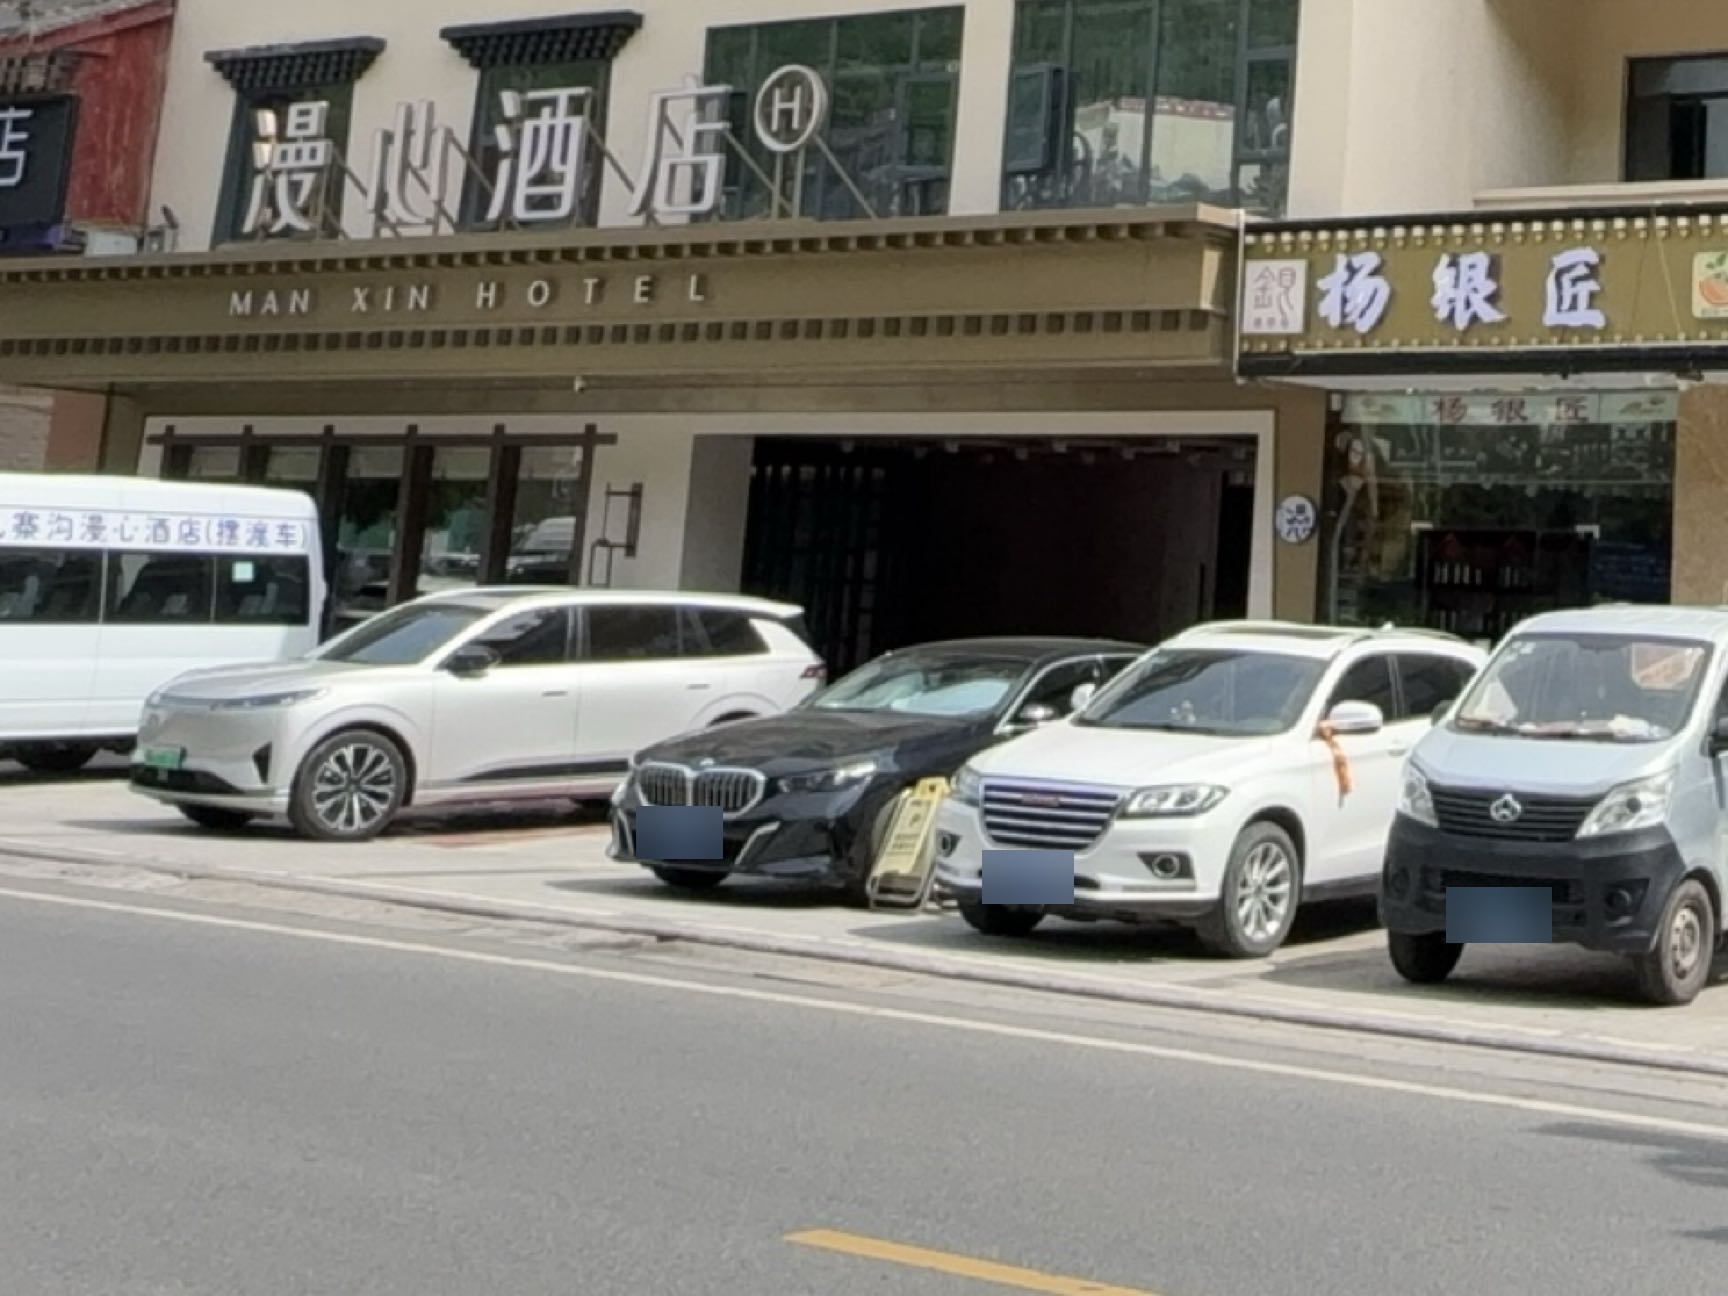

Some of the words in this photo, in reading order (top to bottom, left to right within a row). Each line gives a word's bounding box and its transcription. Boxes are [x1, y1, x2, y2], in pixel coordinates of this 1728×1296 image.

[243, 76, 731, 237] 漫心酒店
[231, 289, 311, 316] MAN
[351, 283, 430, 312] XIN
[477, 275, 710, 309] HOTEL
[1317, 246, 1606, 333] 杨银匠
[1433, 395, 1589, 424] 杨银匠
[0, 510, 310, 549] 寨沟漫心酒店(摆渡车)
